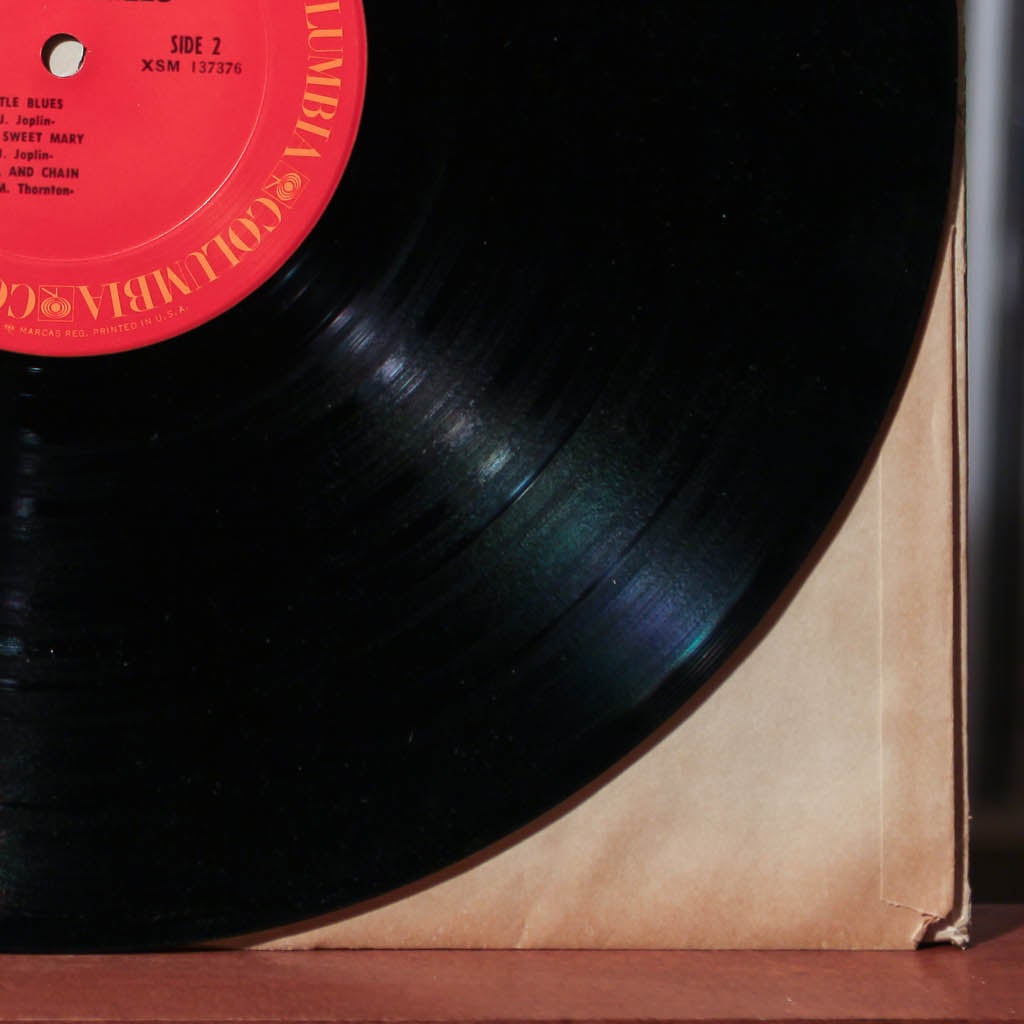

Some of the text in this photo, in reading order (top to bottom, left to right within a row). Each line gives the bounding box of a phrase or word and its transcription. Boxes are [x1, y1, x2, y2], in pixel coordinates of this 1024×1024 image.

[170, 34, 221, 56] SIDE 2
[141, 58, 242, 74] XSM 137376
[26, 97, 64, 110] BLUES
[2, 130, 43, 143] SWEET
[49, 132, 85, 145] MARY
[8, 165, 35, 178] AND
[41, 166, 80, 179] CHAIN
[78, 197, 282, 320] COLUMBIA
[20, 327, 61, 338] MARCAS
[65, 328, 88, 338] REG.
[93, 321, 137, 336] PRINTED
[140, 318, 151, 327] IN
